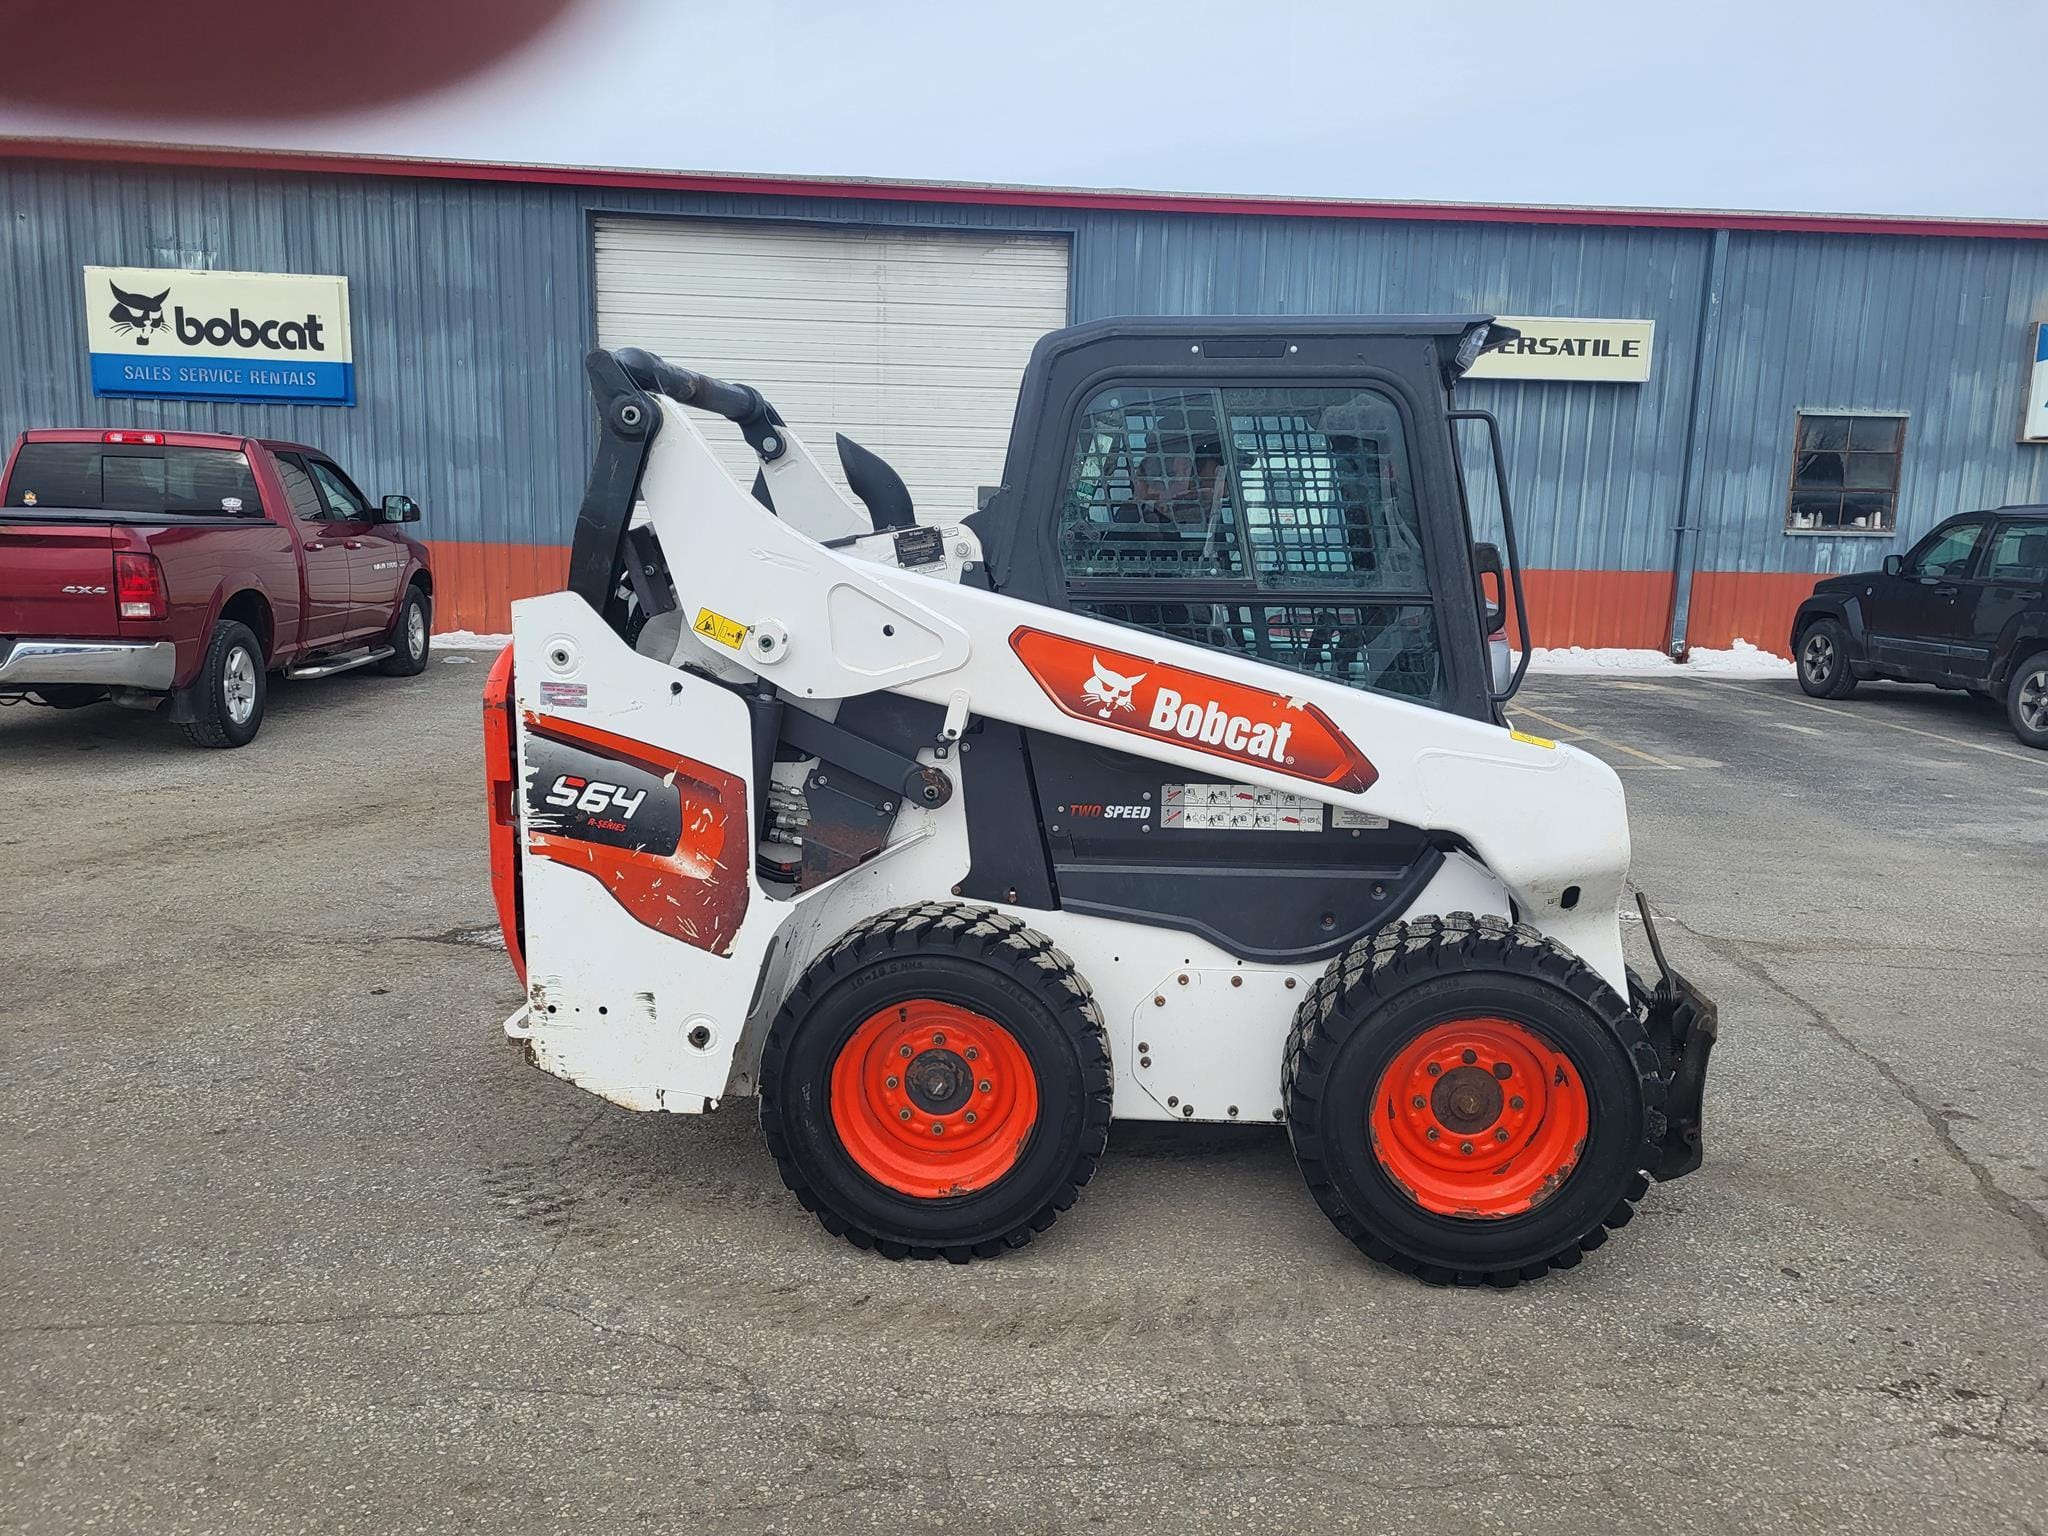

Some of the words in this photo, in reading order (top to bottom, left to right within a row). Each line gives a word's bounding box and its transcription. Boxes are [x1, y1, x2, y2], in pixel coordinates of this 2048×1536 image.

[174, 306, 325, 351] bobcat
[1488, 336, 1641, 358] ERSATILE
[124, 366, 171, 381] SALES
[179, 367, 242, 383] SERVICE
[250, 370, 316, 386] RENTALS
[1149, 687, 1292, 763] Bobcat
[545, 775, 647, 819] S64
[1070, 804, 1103, 817] TWO
[1104, 805, 1151, 819] SPEED
